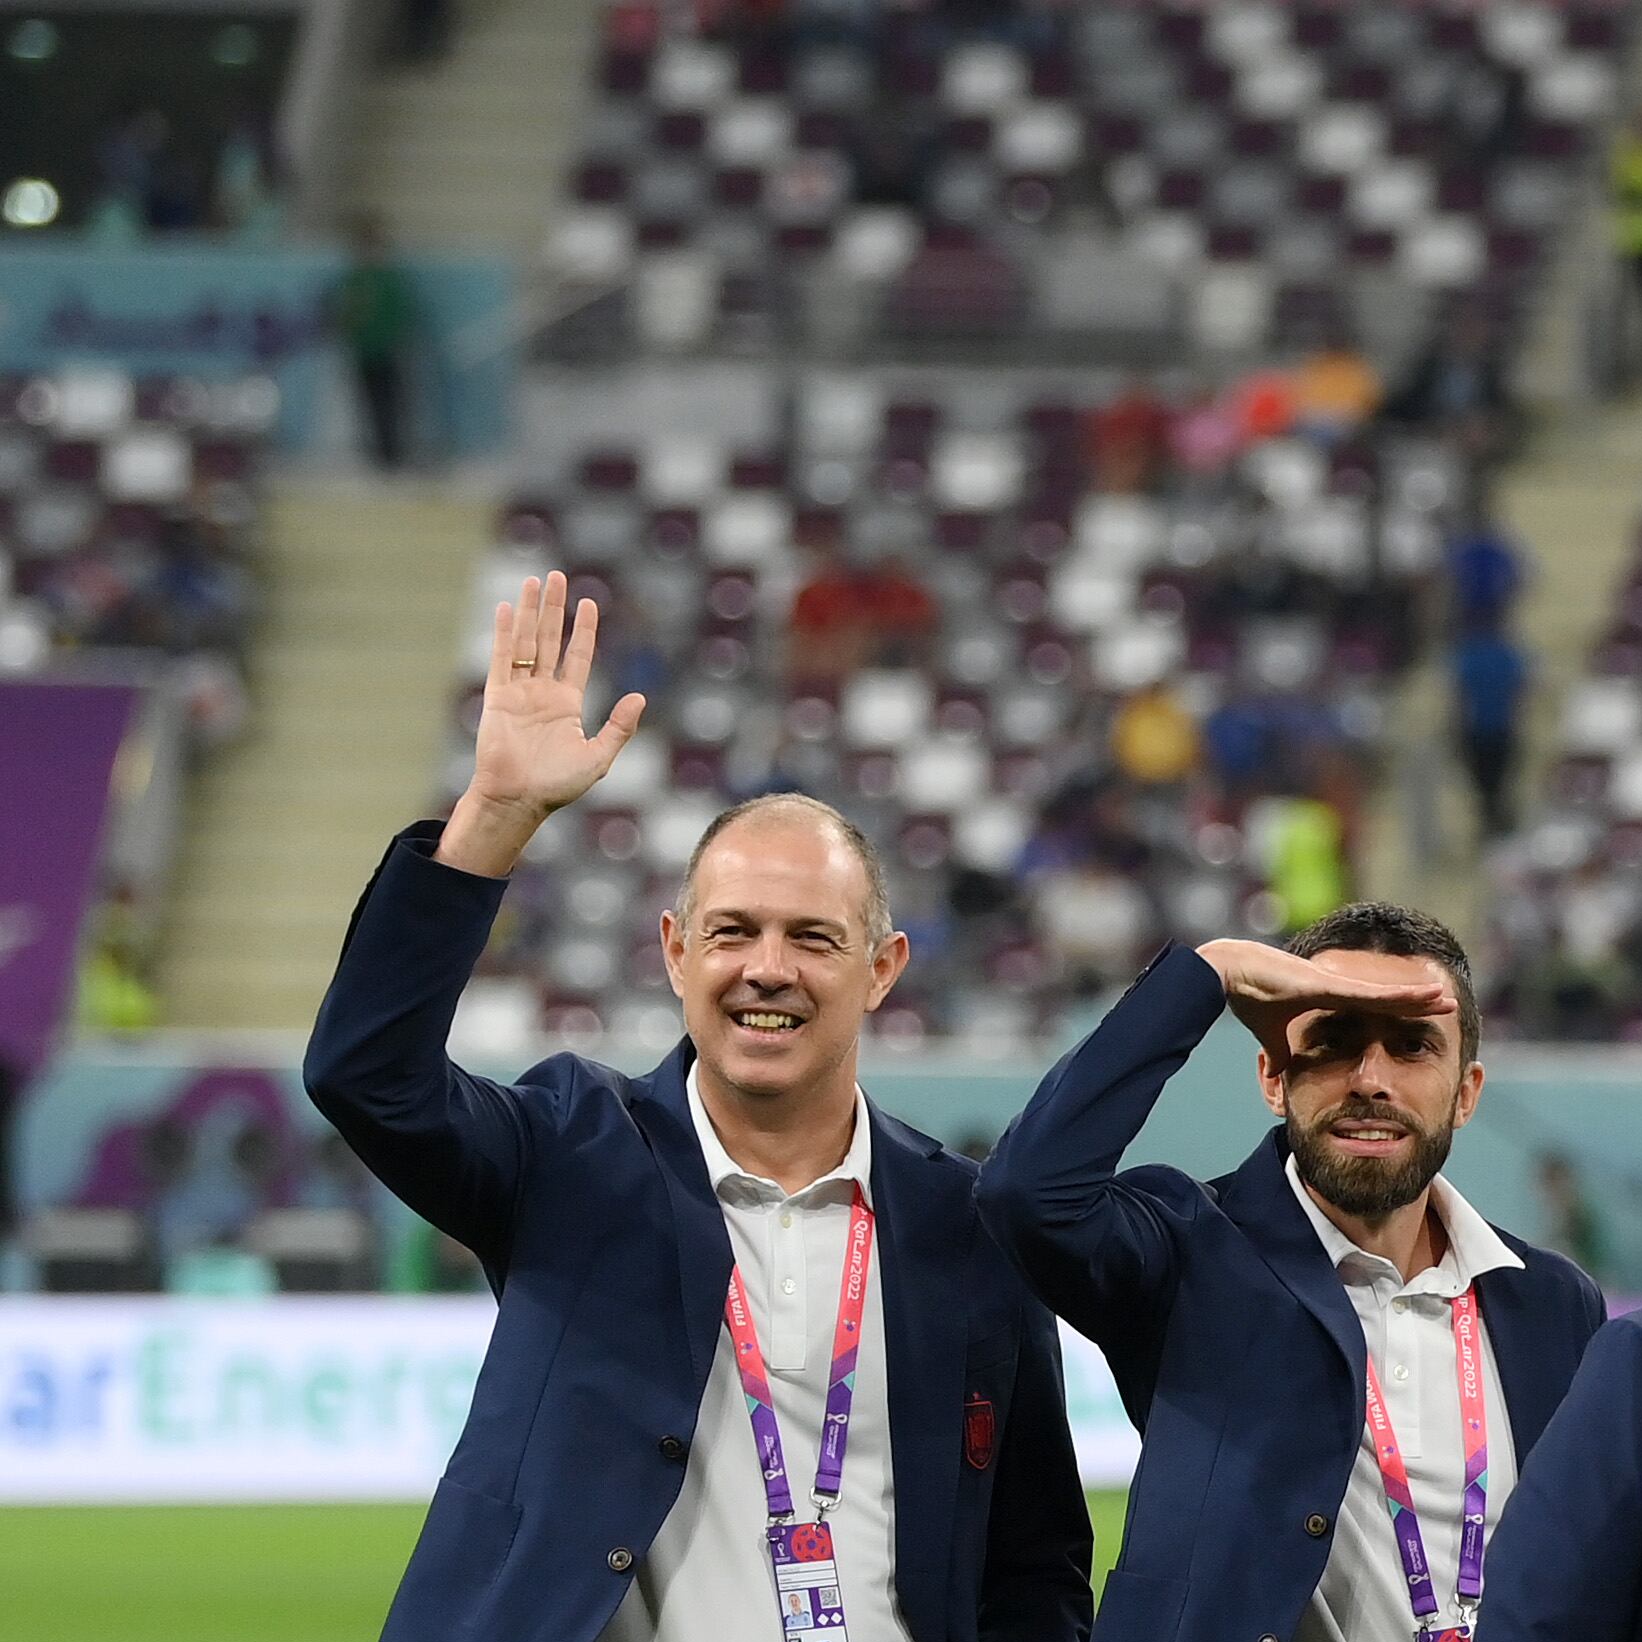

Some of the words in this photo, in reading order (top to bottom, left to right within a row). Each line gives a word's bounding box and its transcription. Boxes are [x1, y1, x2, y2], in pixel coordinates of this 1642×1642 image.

[847, 1219, 869, 1300] Qatar2022
[731, 1299, 747, 1327] FIFA
[1457, 1314, 1477, 1398] Qatar2022
[1370, 1403, 1387, 1431] FIFA
